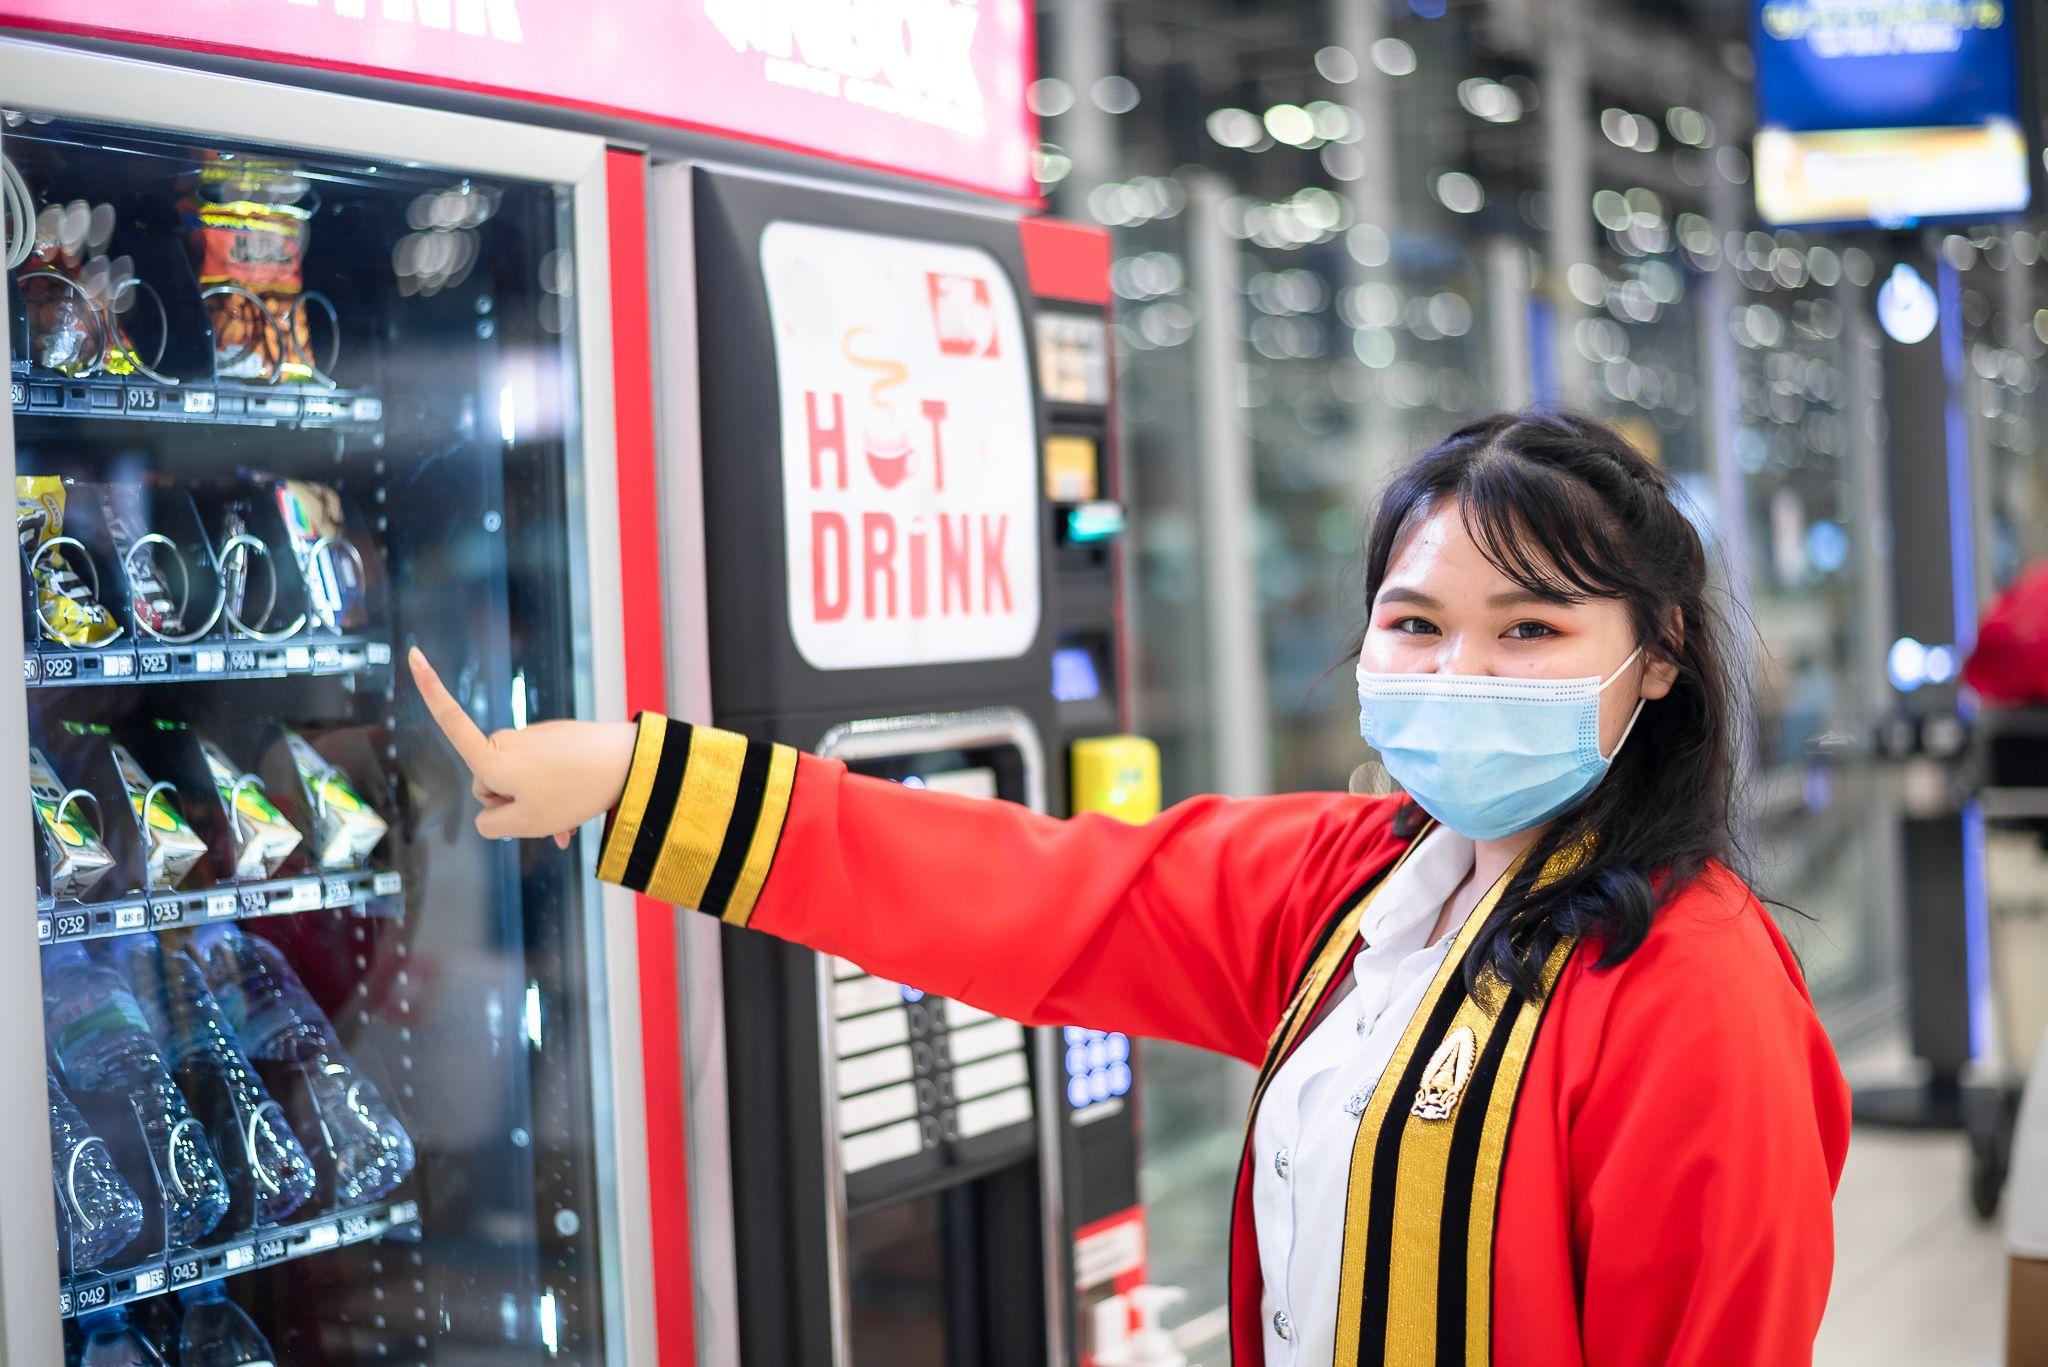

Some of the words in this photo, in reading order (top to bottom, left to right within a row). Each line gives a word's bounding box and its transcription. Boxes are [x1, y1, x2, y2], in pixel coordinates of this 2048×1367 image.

[129, 389, 156, 408] 913
[46, 658, 73, 677] 922
[142, 653, 168, 673] 923
[152, 901, 180, 922] 933
[58, 914, 85, 936] 932
[171, 1261, 199, 1283] 943
[79, 1286, 105, 1308] 942
